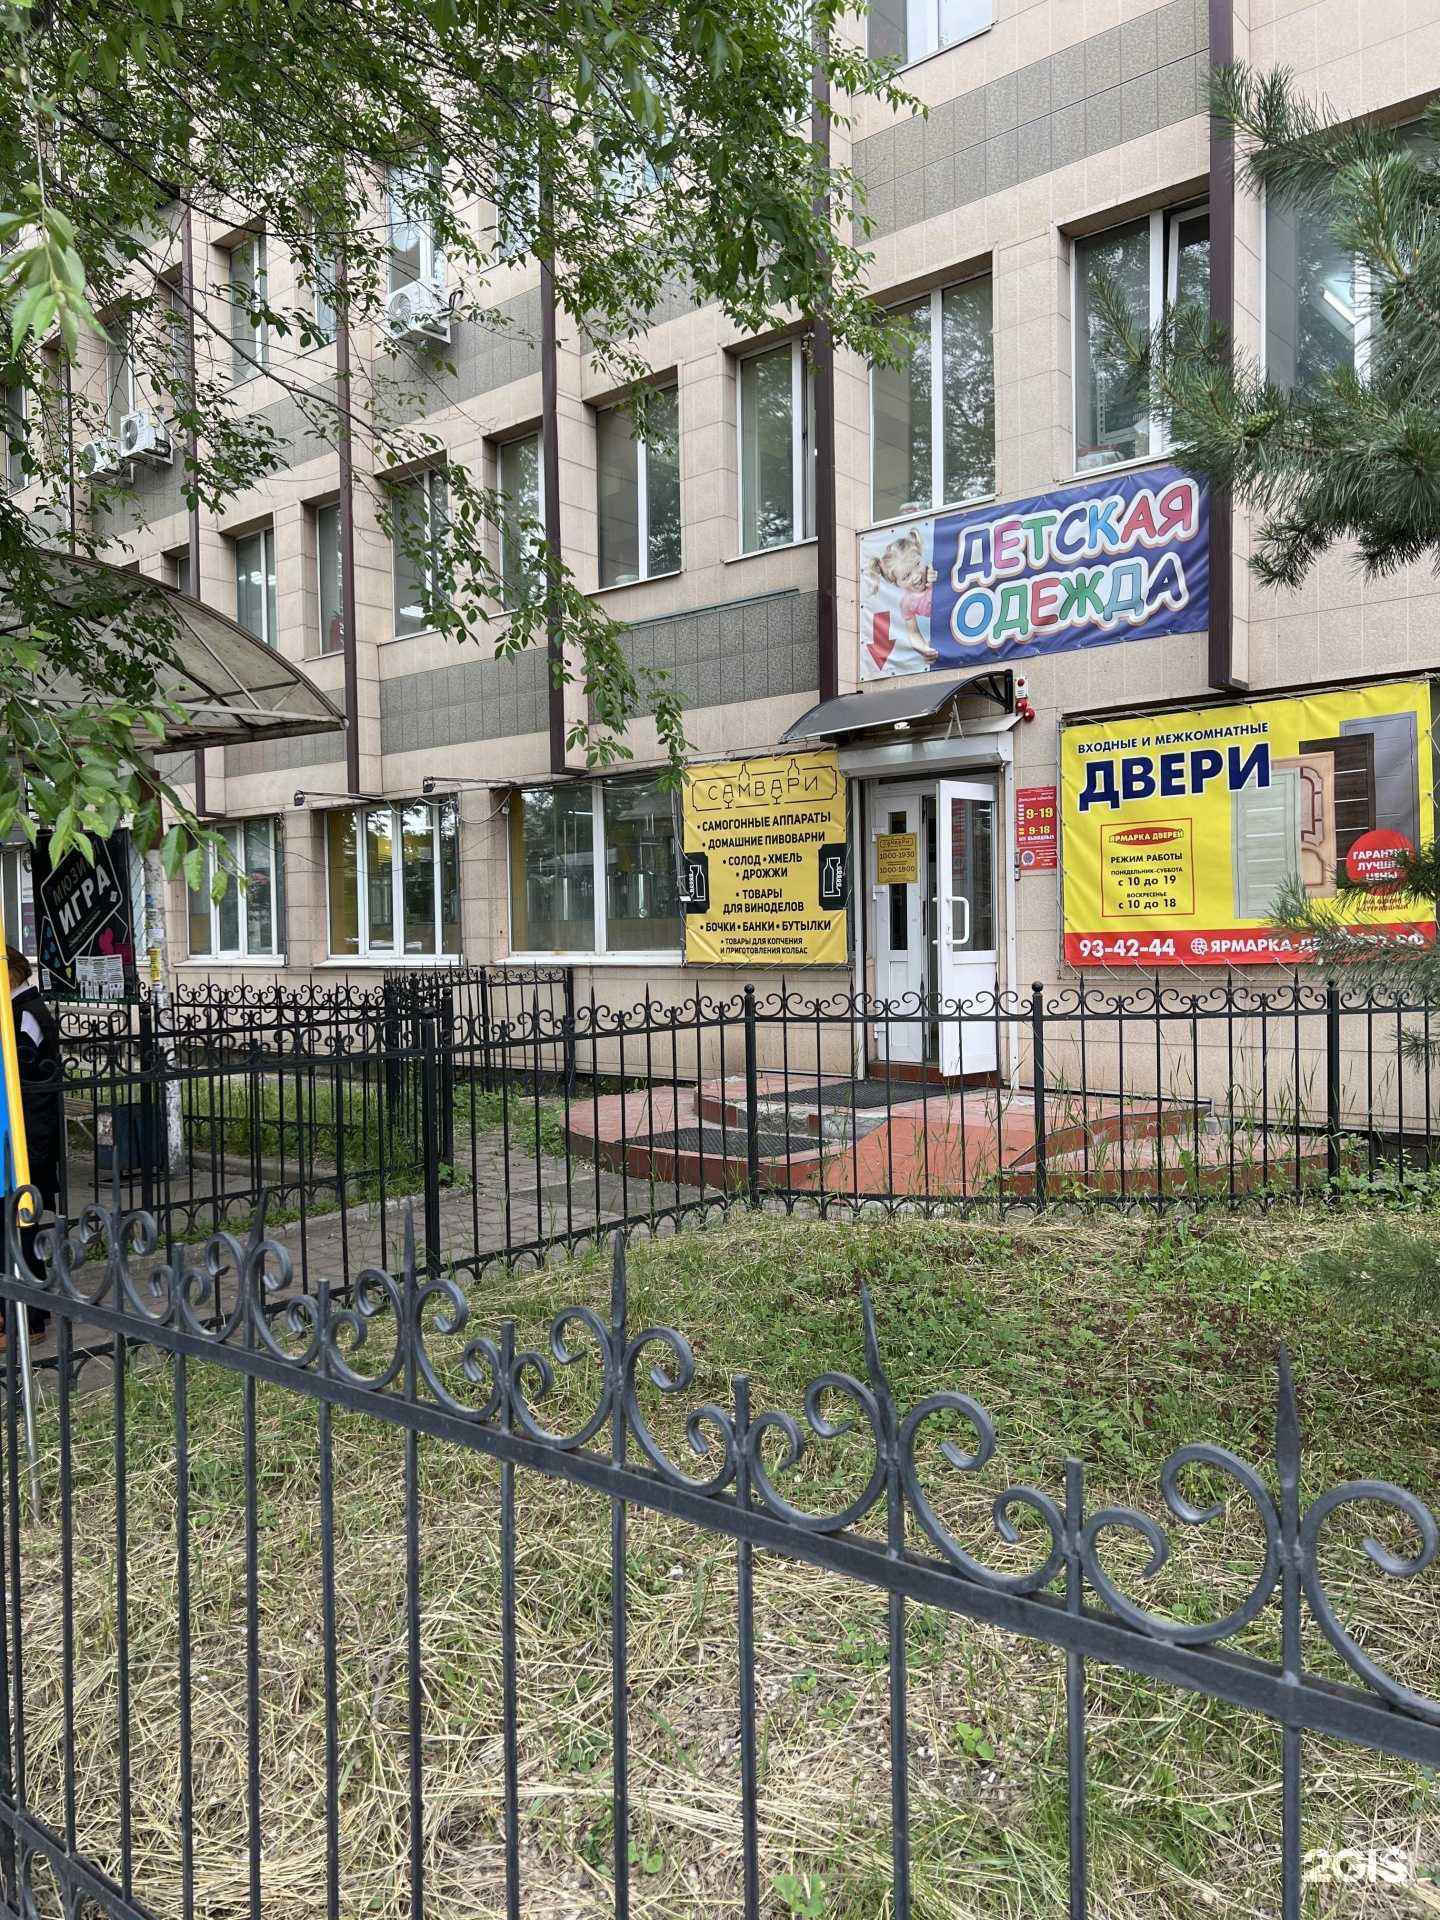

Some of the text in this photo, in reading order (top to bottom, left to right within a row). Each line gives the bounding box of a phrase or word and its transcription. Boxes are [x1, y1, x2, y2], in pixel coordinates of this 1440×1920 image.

[957, 484, 1194, 583] ДЕТСКАЯ
[955, 558, 1184, 640] ОДЕЖДА
[1077, 722, 1269, 754] ВХОДНЫЕ И МЕЖКОМНАТНЫЕ
[1078, 743, 1271, 812] ДВЕРИ
[707, 775, 818, 808] САМВАРИ
[702, 811, 831, 831] САМОГОННЫЕ АППАРАТЫ
[708, 831, 825, 850] ДОМАШНИЕ ПИВОВАРНИ
[1109, 828, 1184, 843] ЯРМАРКА ДВЕРЕЙ
[728, 852, 803, 867] СОЛОД ХМЕЛЬ
[1111, 852, 1183, 863] РЕЖИМ РАБОТЫ
[742, 867, 788, 880] ДРОЖЖИ
[1128, 877, 1140, 886] 10
[1143, 878, 1159, 887] до
[1164, 875, 1176, 884] 19
[58, 864, 111, 936] ИГРА
[742, 888, 782, 900] ТОВАРЫ
[723, 901, 804, 915] ДЛЯ ВИНОДЕЛОВ
[1128, 900, 1140, 909] 10
[1143, 902, 1159, 910] до
[1164, 898, 1176, 907] 18
[706, 919, 831, 932] БОЧКИ БАНКИ БУТЫЛКИ
[752, 937, 766, 945] ДЛЯ
[767, 937, 803, 945] КОПЧЕНИЯ
[1079, 938, 1176, 957] 93-42-44
[726, 946, 781, 954] ПРИГОТОВЛЕНИЯ
[781, 946, 808, 954] КОЛБАС
